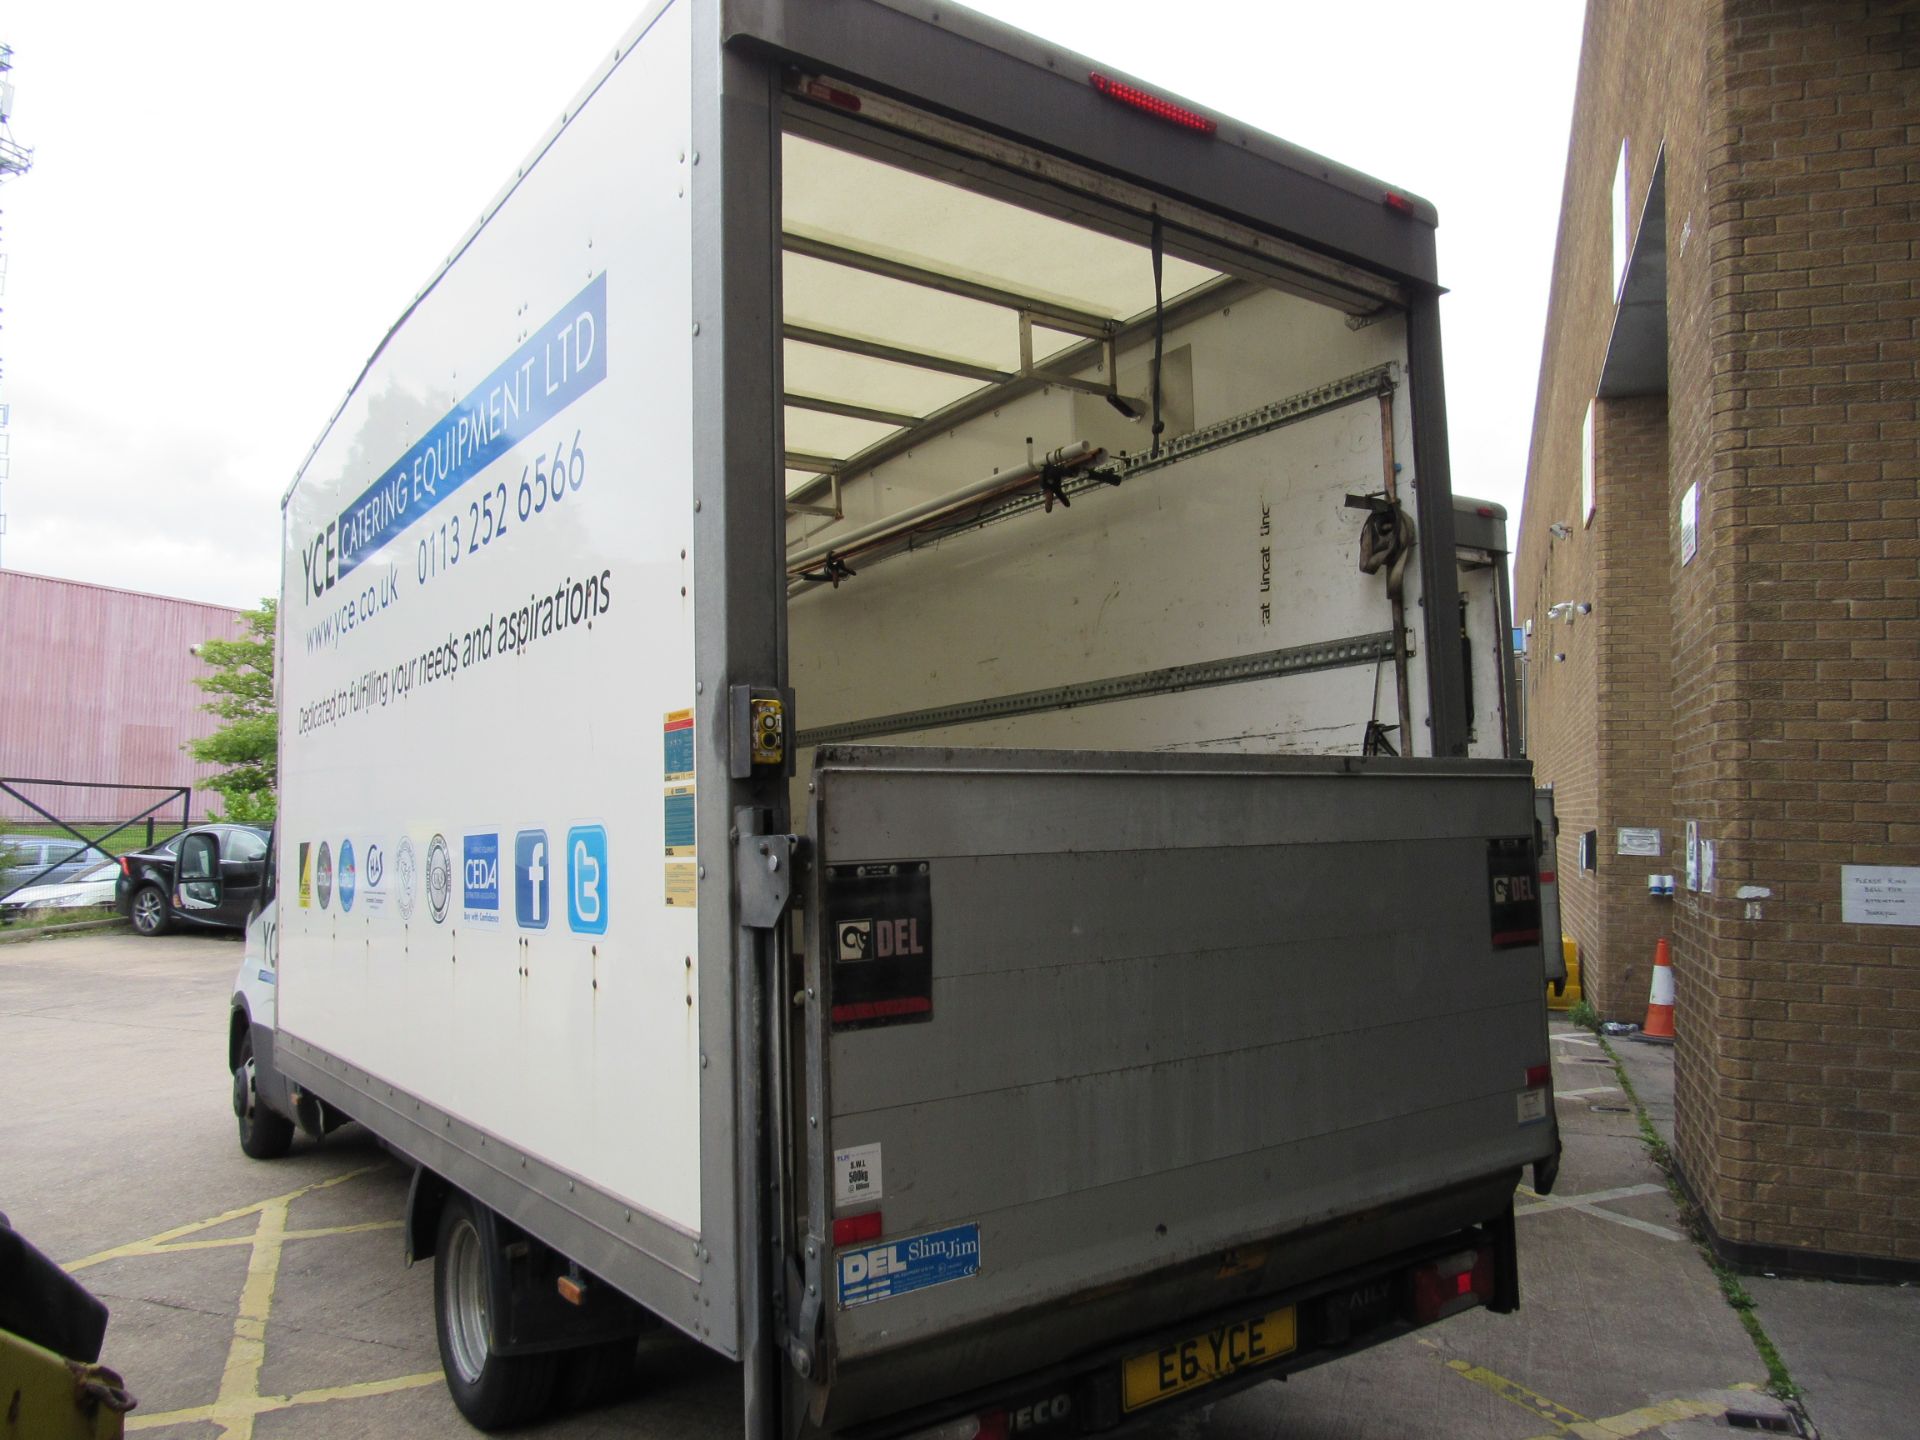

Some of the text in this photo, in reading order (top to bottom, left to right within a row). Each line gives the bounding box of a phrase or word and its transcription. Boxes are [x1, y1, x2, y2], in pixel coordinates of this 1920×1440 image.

[302, 311, 596, 607] YCE CATERING EQUIPMENT LTD
[305, 428, 586, 657] www.yce.co.uk 0113 252 6566
[1260, 545, 1271, 592] Lincat
[298, 567, 612, 735] Dedicated to fulfilling your needs and aspirations
[465, 858, 497, 890] CEDA
[1511, 875, 1536, 902] DEL
[875, 917, 924, 958] DEL
[843, 1246, 907, 1286] DEL
[1158, 1317, 1267, 1392] E6 YCE
